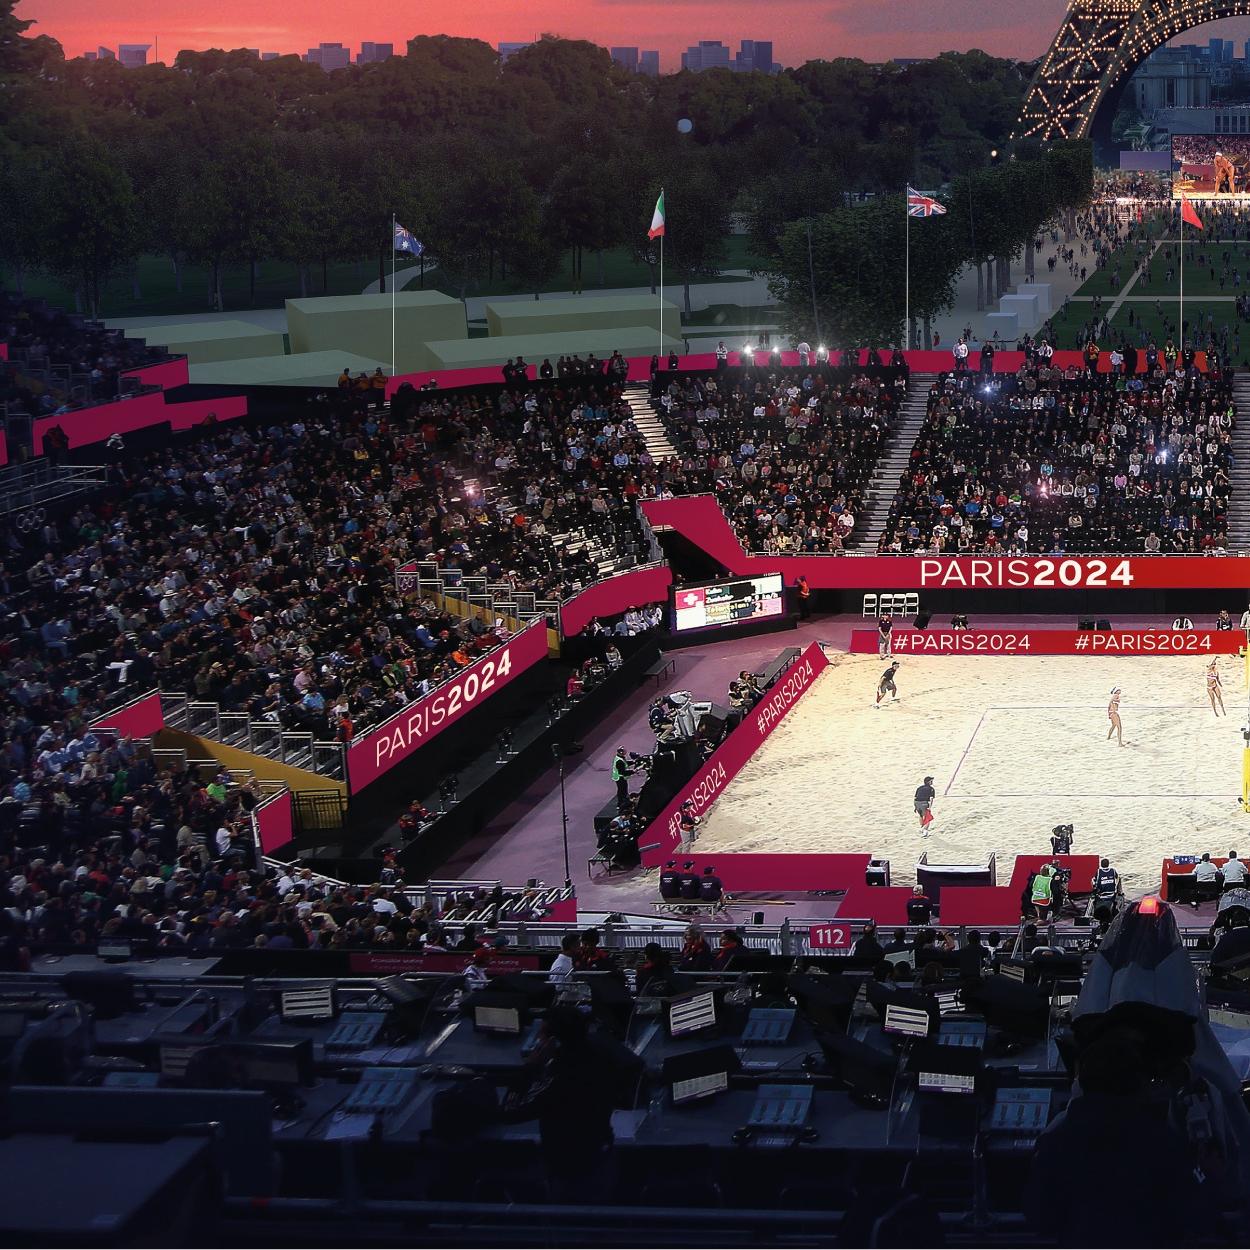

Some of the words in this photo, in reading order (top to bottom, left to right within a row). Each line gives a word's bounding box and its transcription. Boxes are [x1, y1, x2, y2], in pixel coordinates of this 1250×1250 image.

[921, 560, 1134, 587] PARIS2024
[893, 634, 1031, 651] #PARIS2024
[1074, 634, 1212, 651] #PARIS2024
[375, 648, 513, 769] PARIS2024
[756, 658, 814, 736] #PARIS2024
[668, 761, 727, 840] #PRIS2024
[816, 928, 845, 945] 112
